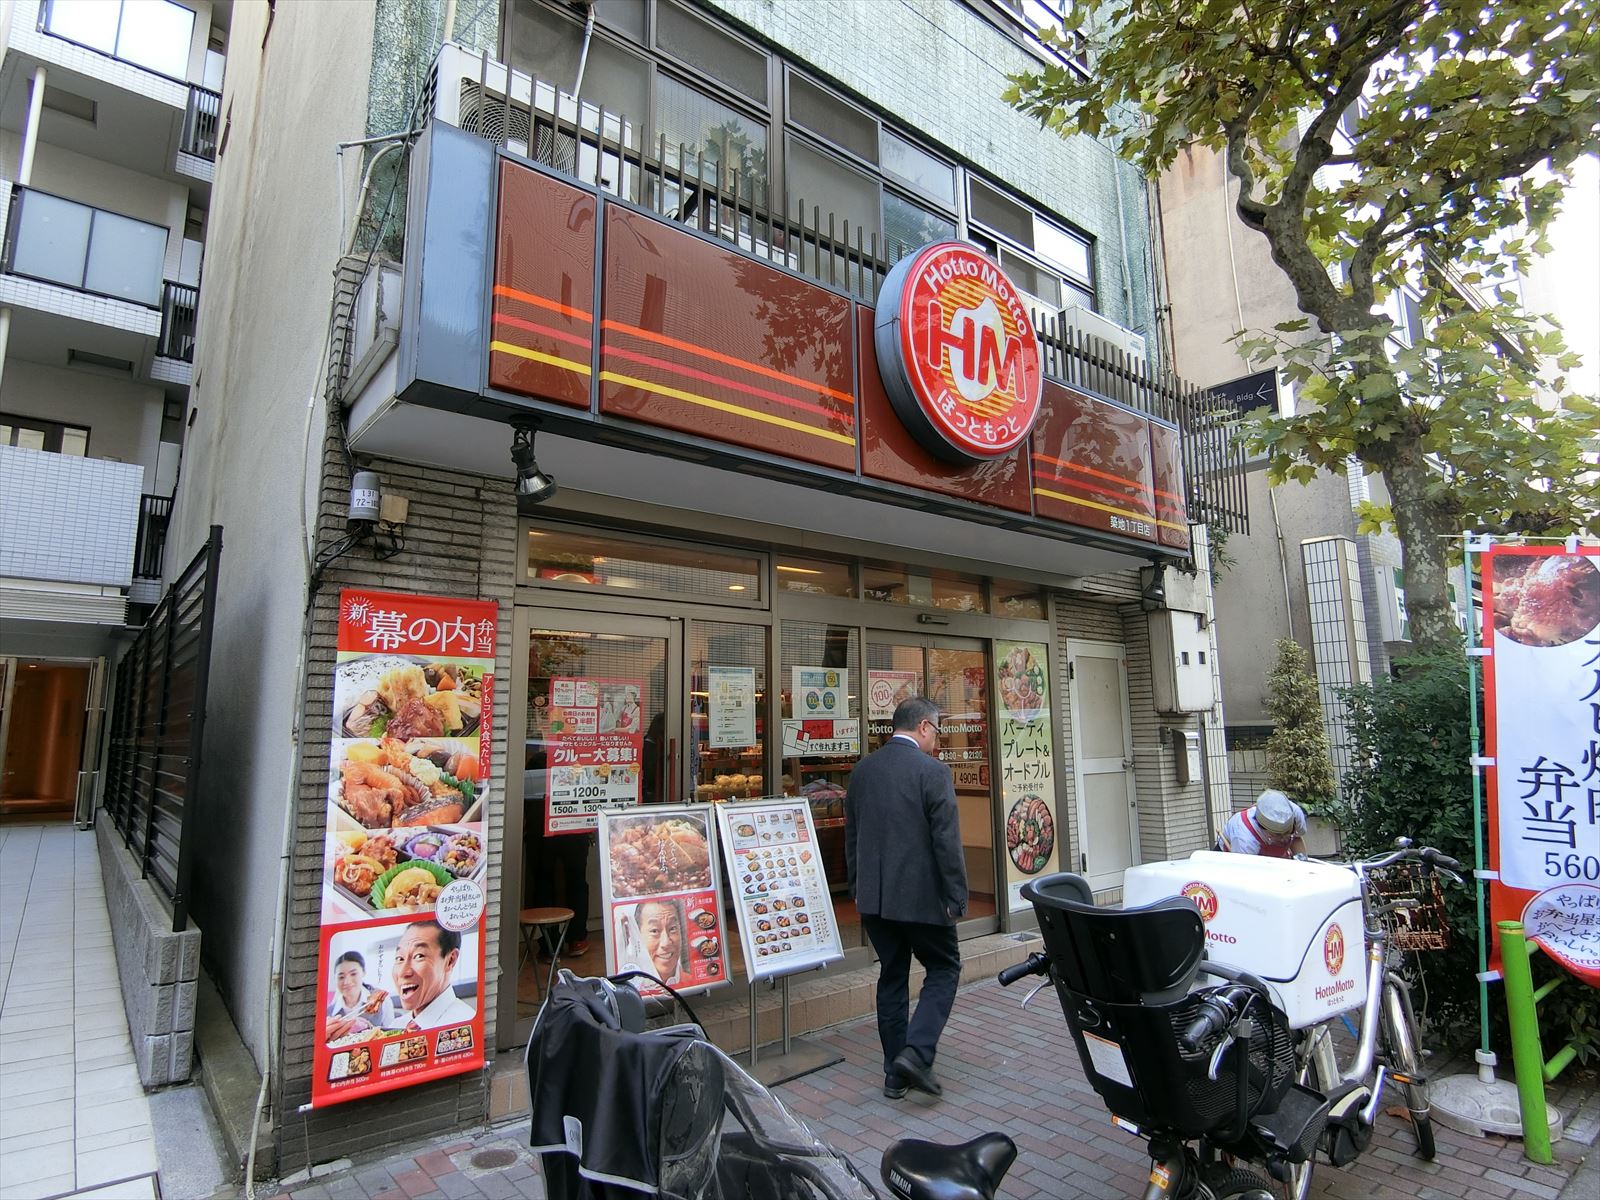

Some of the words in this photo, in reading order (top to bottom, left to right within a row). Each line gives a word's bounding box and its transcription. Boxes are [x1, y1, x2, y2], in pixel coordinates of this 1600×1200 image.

[924, 257, 979, 294] Hotto
[981, 261, 1028, 336] Motto
[937, 388, 1022, 443] ほっともっと
[1109, 515, 1151, 537] 築地1丁目店
[350, 602, 369, 625] 新
[364, 609, 476, 653] 幕の内
[476, 618, 495, 654] 弁当
[1003, 719, 1045, 738] パーティ
[553, 747, 638, 763] クルー大募集!
[1004, 739, 1050, 759] プレート&
[1004, 761, 1051, 781] オードブル
[572, 786, 607, 798] 1200円
[1517, 755, 1581, 850] 弁当
[553, 806, 578, 814] 1500円
[1315, 979, 1355, 1001] HottoMotto
[889, 1168, 912, 1195] YAMAHA
